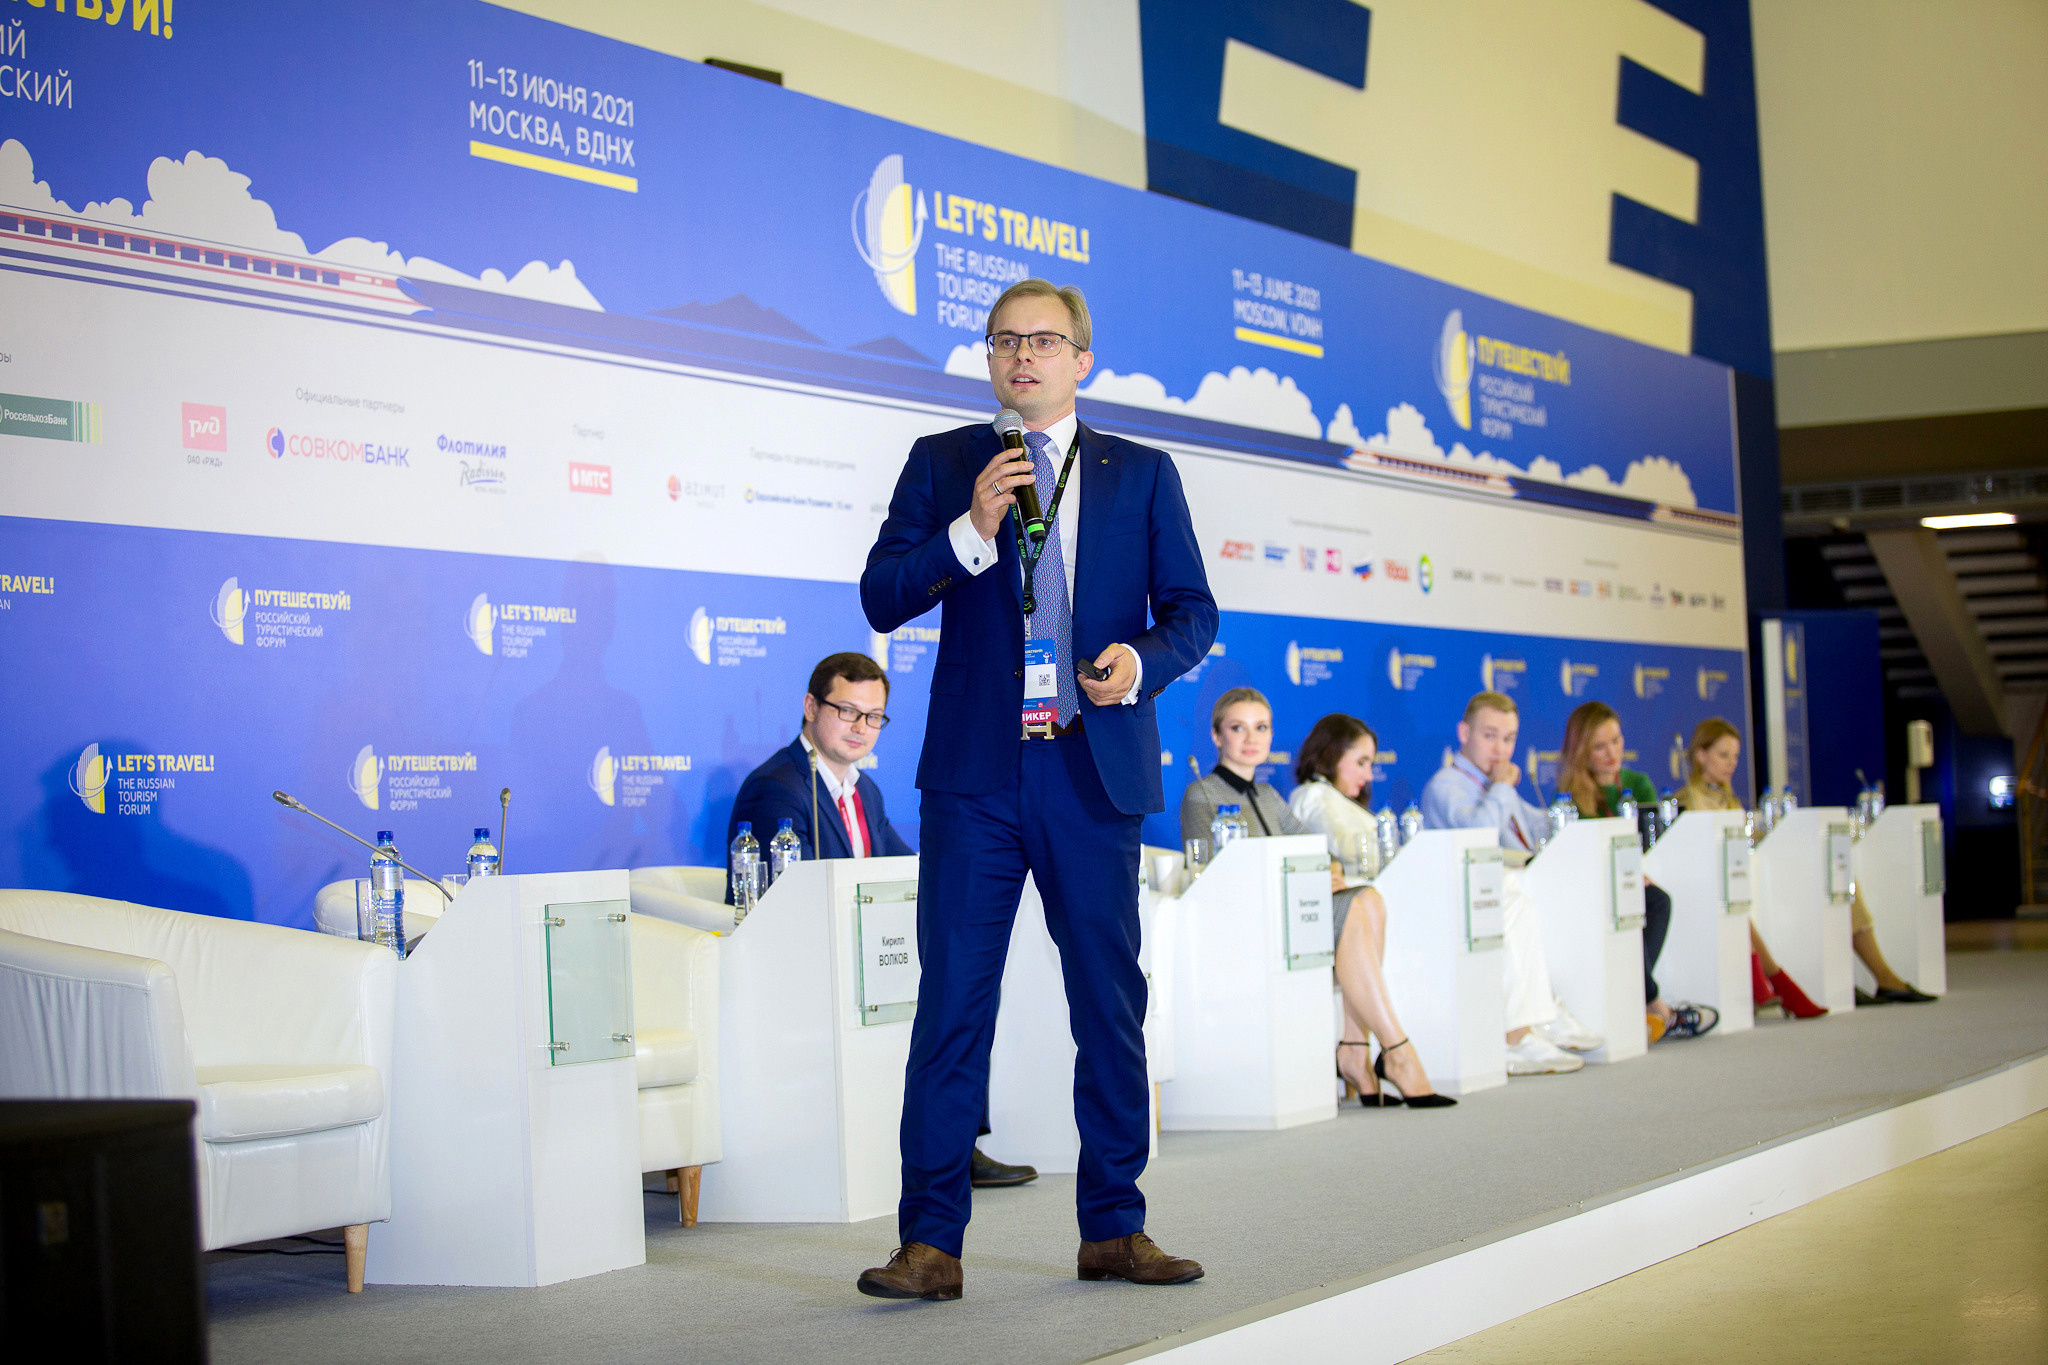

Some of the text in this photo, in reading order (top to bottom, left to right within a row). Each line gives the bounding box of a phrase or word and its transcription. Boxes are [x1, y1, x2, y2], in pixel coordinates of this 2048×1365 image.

[0, 65, 72, 109] СКИЙ
[523, 73, 587, 116] ИЮНЯ
[591, 91, 634, 128] 2021
[470, 100, 636, 168] МОСКВА, ВДНХ
[934, 191, 1090, 265] LET'S TRAVEL!
[935, 242, 1030, 283] THE RUSSIAN
[1263, 277, 1293, 305] JUNE
[296, 387, 405, 413] Официальные партнеры
[4, 408, 68, 426] РоссельхозБанк
[187, 454, 200, 464] ОАО
[288, 434, 410, 468] СОВКОМБАНК
[0, 575, 54, 595] RAVEL!
[255, 589, 351, 611] ПУТЕШЕСТВУЙ!
[255, 611, 311, 625] РОССИЙСКИЙ
[501, 604, 577, 623] LET'S TRAVEL!
[256, 624, 323, 638] ТУРИСТИЧЕСКИЙ
[256, 636, 286, 648] ФОРУМ
[117, 755, 214, 772] LET'S TRAVEL!
[388, 752, 477, 771] ПУТЕШЕСТВУЙ!
[621, 755, 691, 771] LET'S TRAVEL!
[118, 778, 175, 789] THE RUSSIAN
[118, 791, 157, 802] TOURISM
[119, 804, 151, 815] FORUM
[882, 936, 905, 947] Кирилл
[879, 952, 908, 966] ВОЛКОВ
